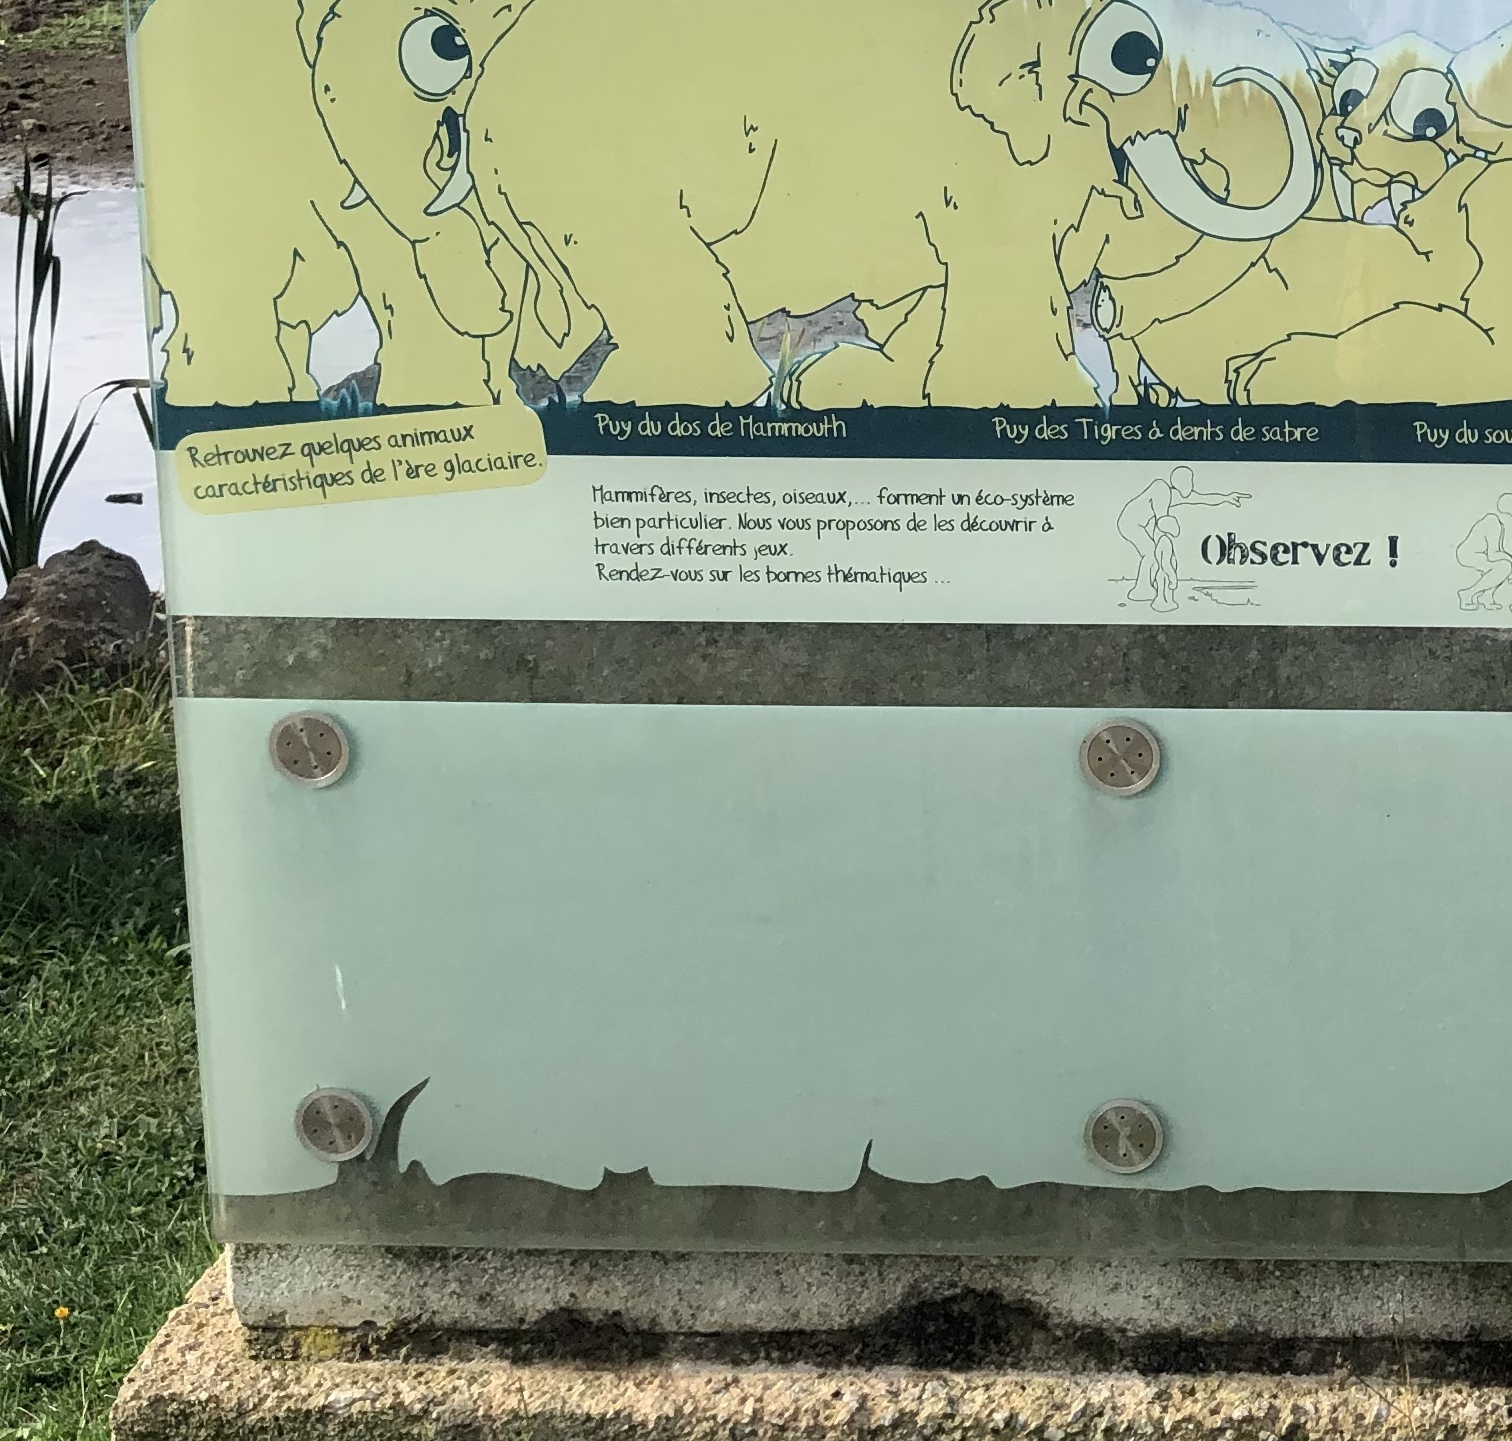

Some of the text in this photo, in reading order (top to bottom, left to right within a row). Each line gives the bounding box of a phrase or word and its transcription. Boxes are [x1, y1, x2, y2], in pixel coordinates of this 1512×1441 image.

[594, 412, 847, 441] Puy du dos de Mammouth
[991, 415, 1320, 445] Puy des Tigres à dents de sabre
[1412, 420, 1450, 448] Puy
[1455, 420, 1479, 444] du
[186, 423, 476, 469] Retrouvez quelques animaux
[193, 451, 543, 499] caractéristiques de l'ère glaciaire.
[592, 484, 698, 506] Mammifères,
[704, 486, 776, 507] insectes,
[877, 487, 946, 506] forment
[952, 493, 971, 506] un
[975, 488, 1075, 510] éco-système
[593, 511, 1054, 540] bien particulier. Nous vous proposons de les découvrir à
[594, 536, 794, 560] travers différents jeux.
[1201, 532, 1400, 568] Observez !
[595, 562, 704, 582] Rendez-vous
[709, 569, 732, 582] sur
[739, 564, 760, 582] les
[766, 565, 822, 583] bornes
[827, 564, 927, 592] thématiques
